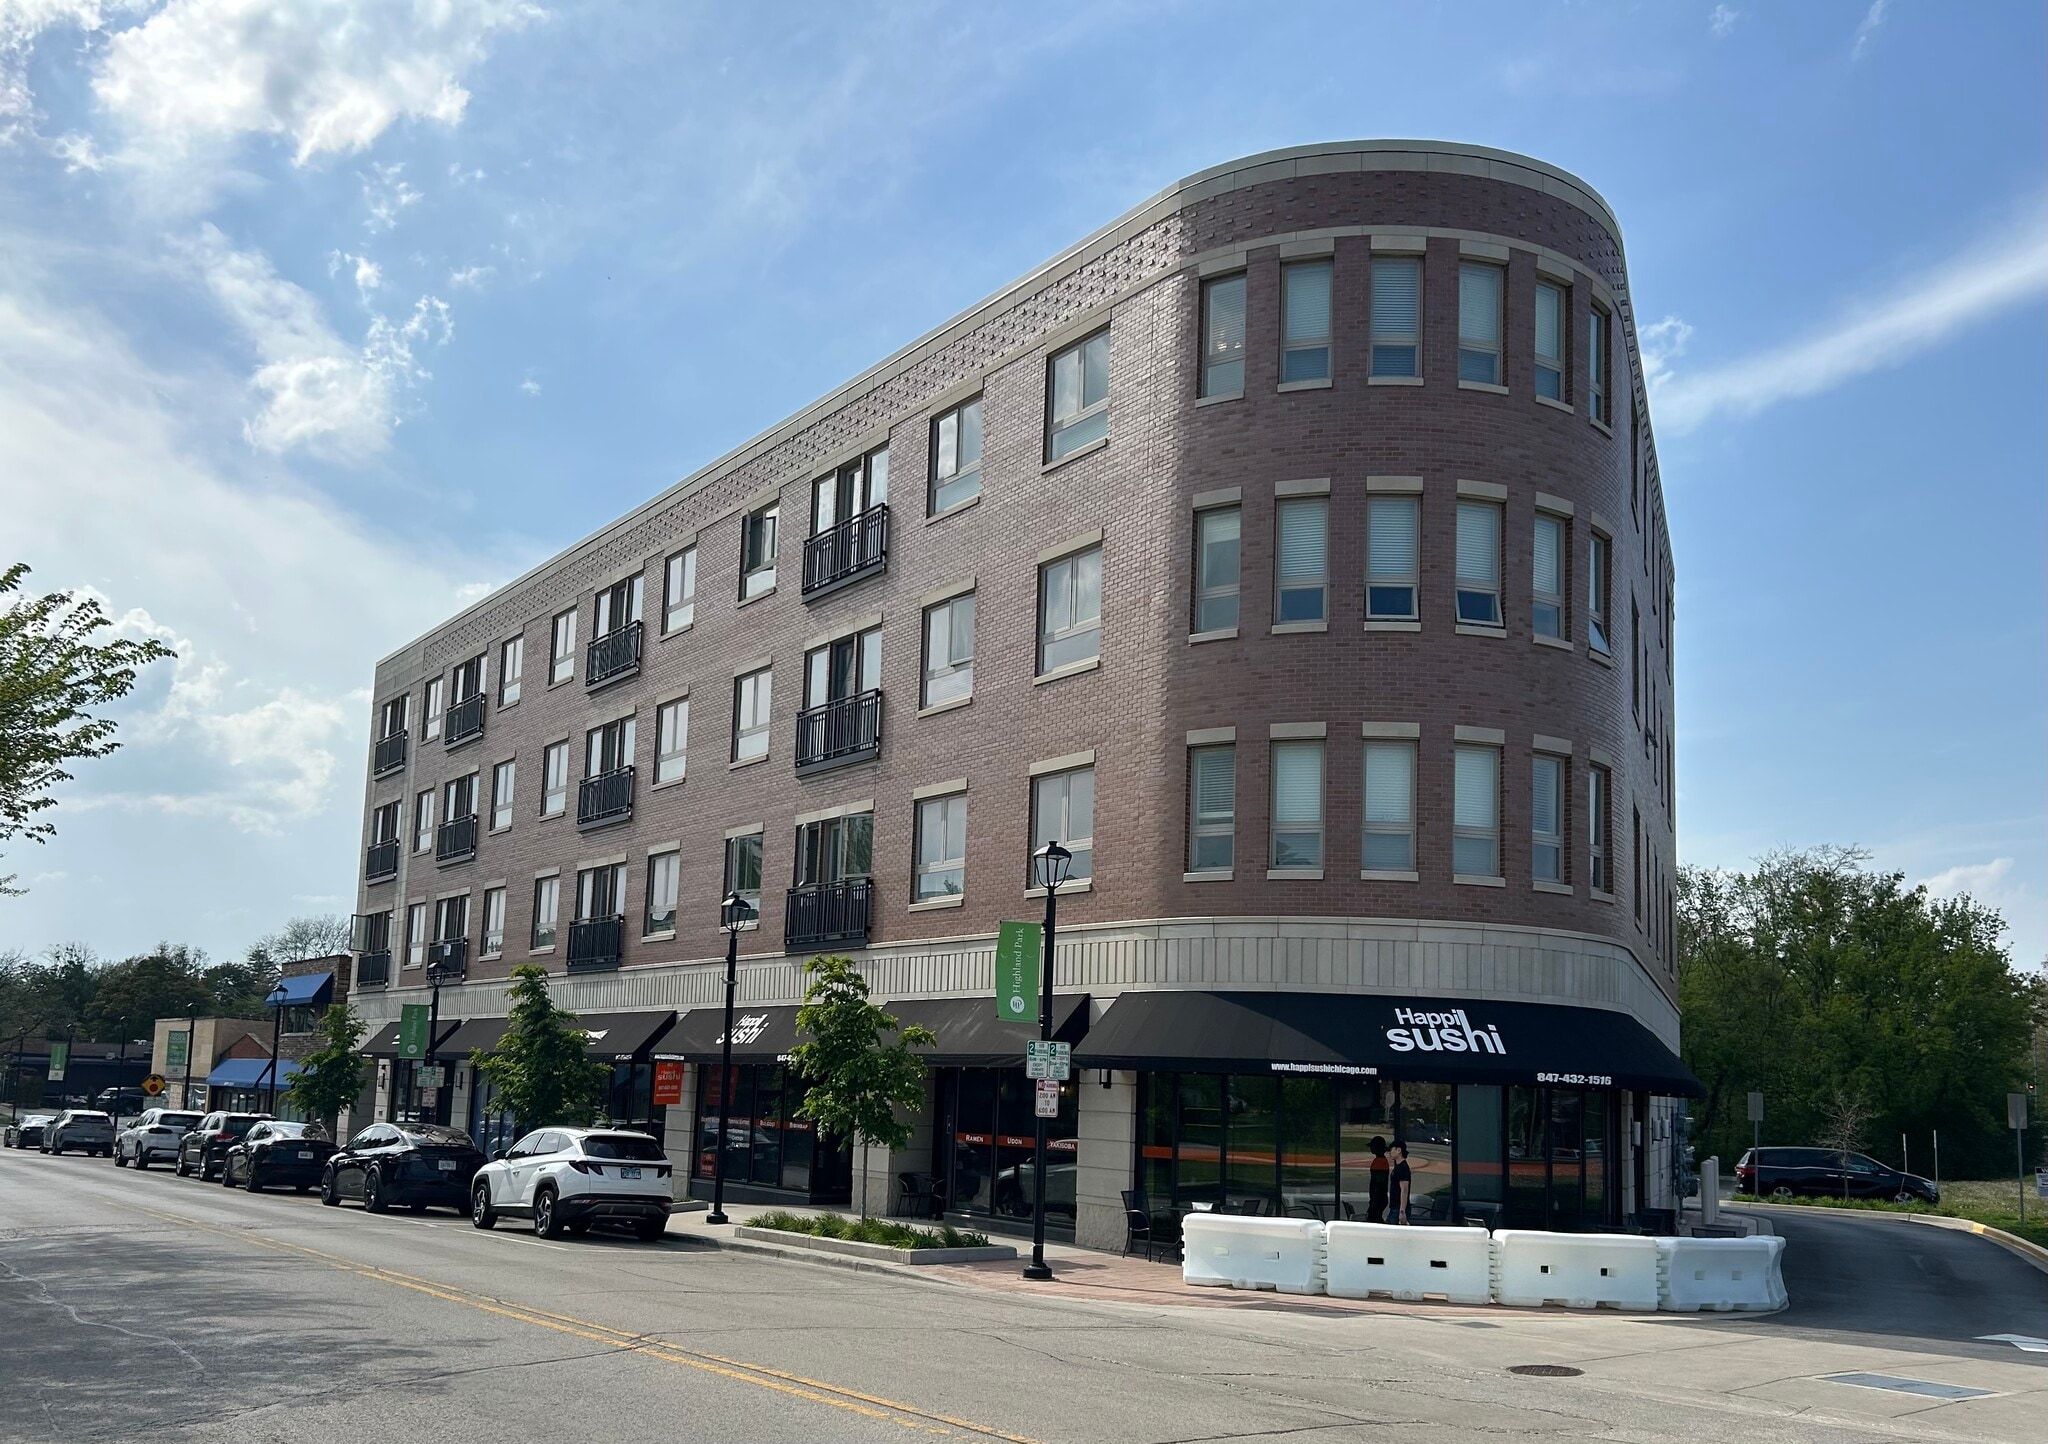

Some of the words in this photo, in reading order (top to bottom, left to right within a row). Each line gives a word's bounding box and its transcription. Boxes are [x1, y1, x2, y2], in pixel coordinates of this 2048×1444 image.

[1014, 927, 1025, 948] Park
[1012, 950, 1023, 993] Highland
[1394, 1007, 1460, 1029] Happi
[1386, 1009, 1507, 1055] sushi
[1029, 1043, 1034, 1053] 2
[1051, 1045, 1056, 1054] 2
[1270, 1062, 1378, 1076] www.happisushichicago.com
[1536, 1072, 1612, 1085] 847-432-1516
